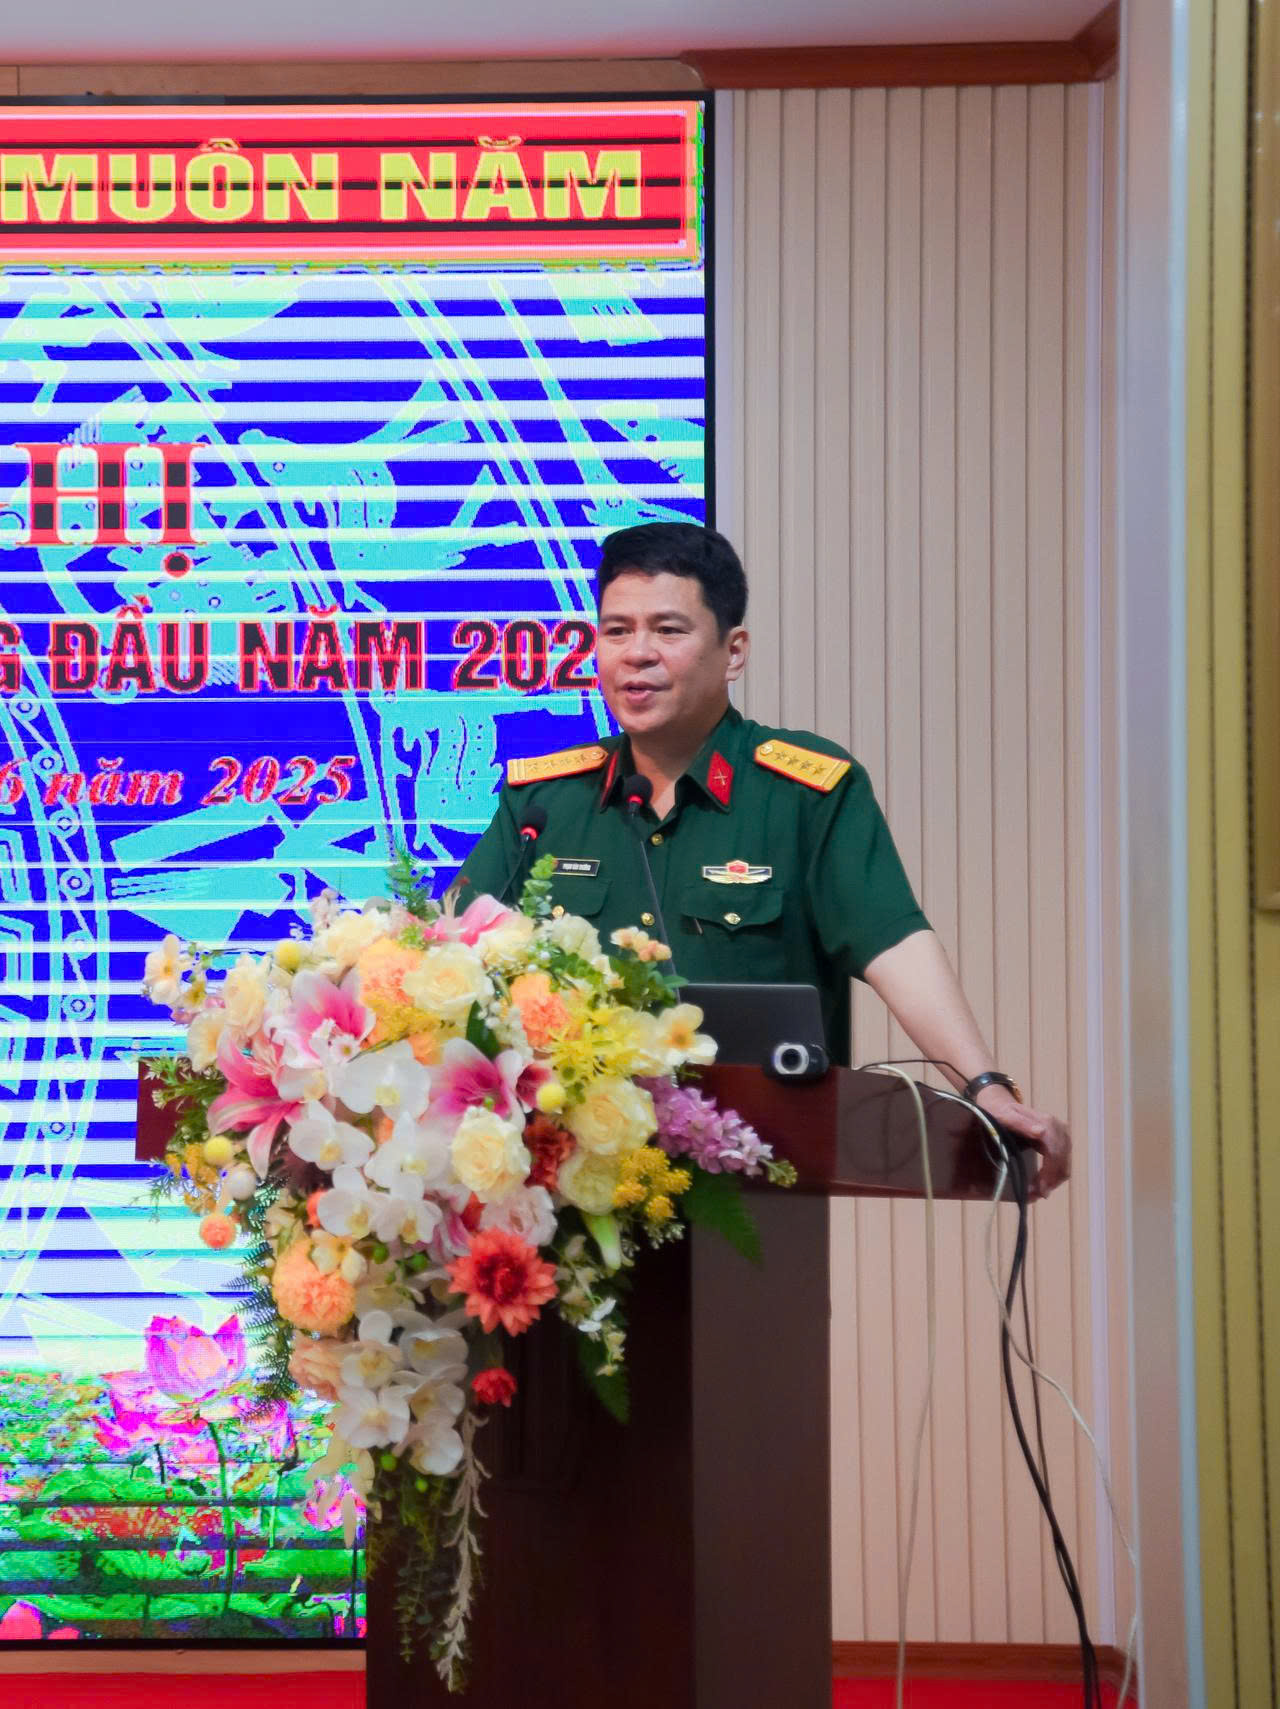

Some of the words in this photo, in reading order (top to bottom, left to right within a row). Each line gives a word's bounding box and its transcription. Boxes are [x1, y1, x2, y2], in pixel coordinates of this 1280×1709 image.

[0, 137, 339, 222] MUÔN
[380, 135, 641, 219] NĂM
[49, 595, 209, 692] ĐẦU
[239, 604, 424, 691] NĂM
[453, 620, 598, 690] 202
[44, 756, 184, 806] năm
[201, 756, 356, 805] 2025
